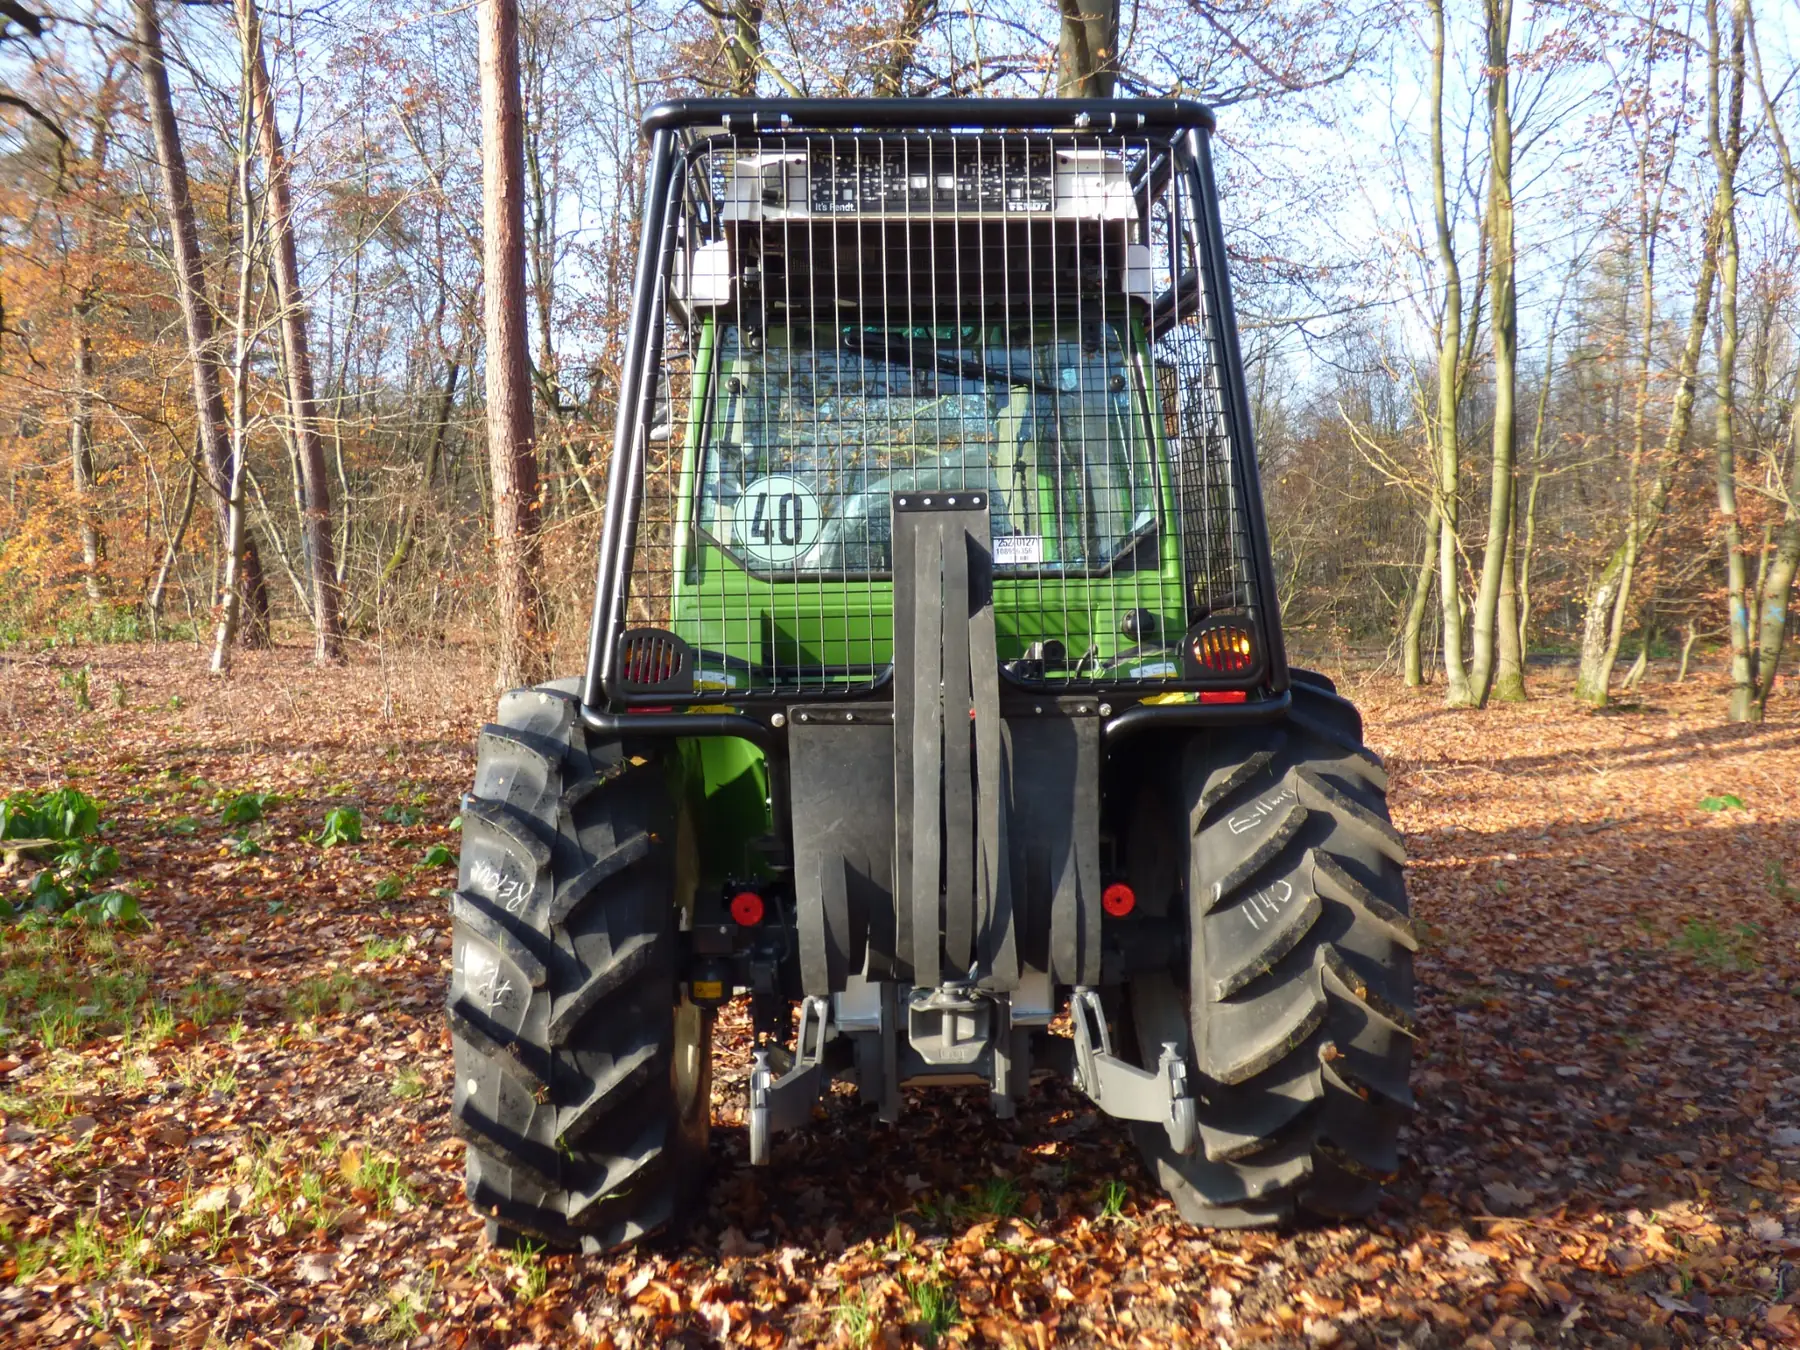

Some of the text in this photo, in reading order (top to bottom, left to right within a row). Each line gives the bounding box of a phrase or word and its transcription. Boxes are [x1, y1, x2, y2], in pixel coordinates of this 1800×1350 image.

[815, 202, 828, 211] It's
[1008, 202, 1049, 212] FENDT
[751, 492, 802, 546] 40
